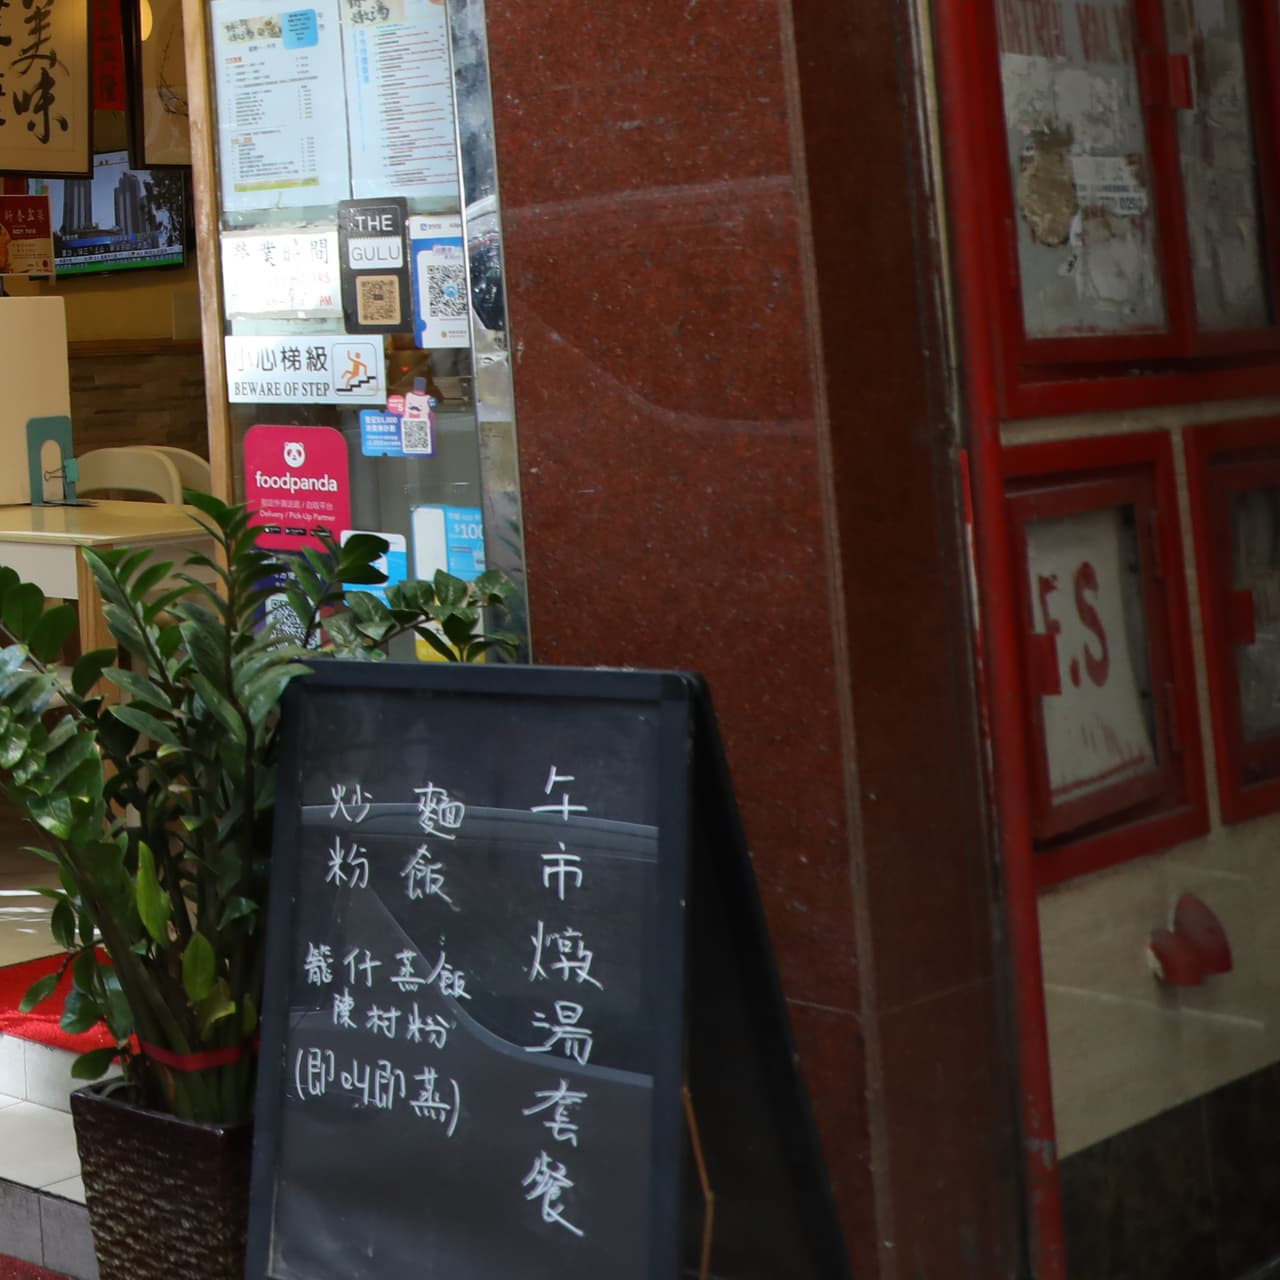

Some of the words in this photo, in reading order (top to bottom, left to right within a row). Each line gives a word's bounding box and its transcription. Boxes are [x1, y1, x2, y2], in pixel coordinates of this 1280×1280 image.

[354, 215, 393, 232] THE
[351, 243, 401, 264] GULU
[234, 381, 282, 397] BEWARE
[284, 382, 300, 397] OF
[301, 382, 330, 397] STEP
[255, 471, 338, 495] foodpanda
